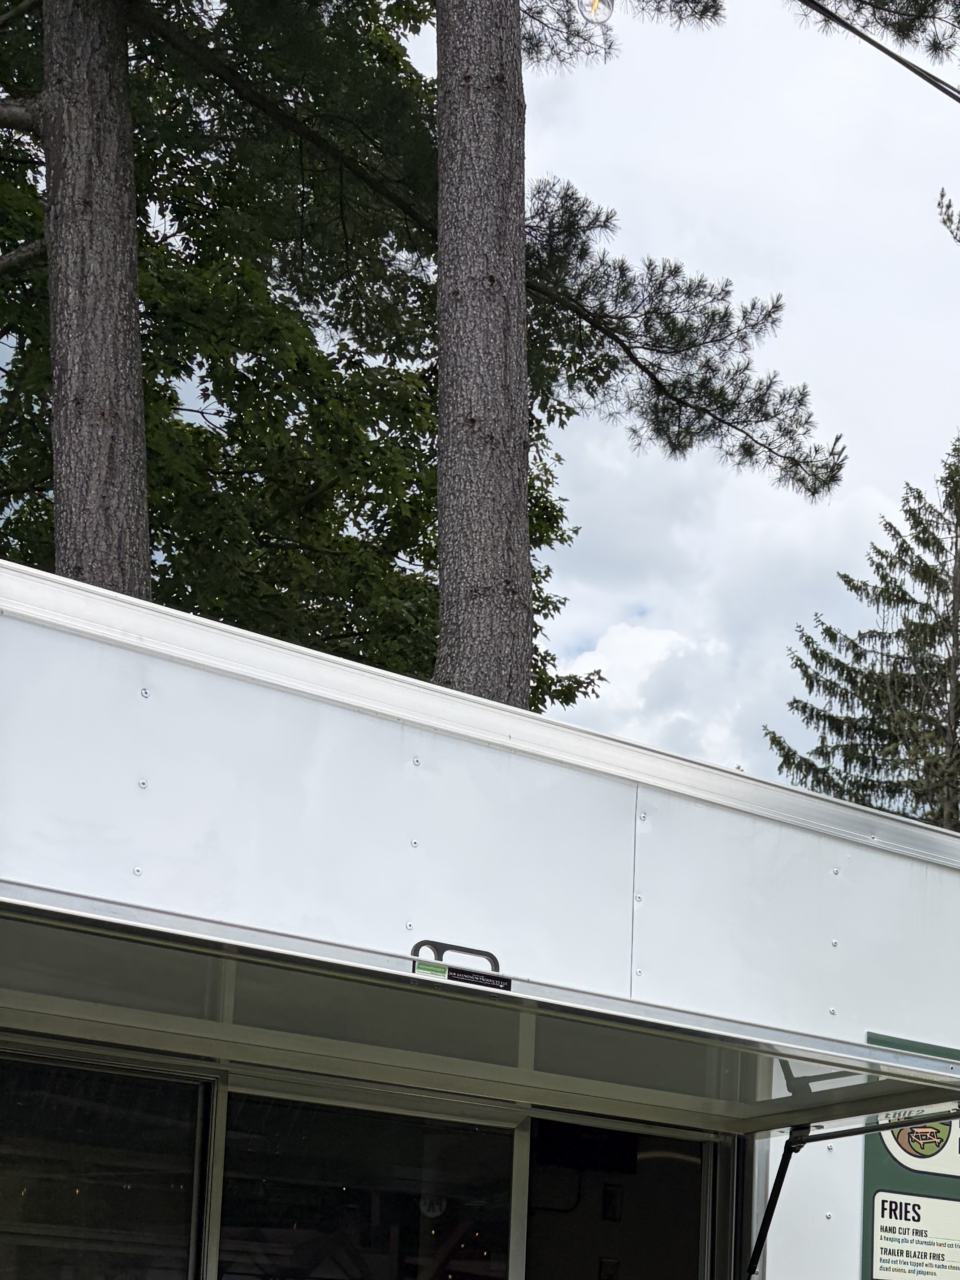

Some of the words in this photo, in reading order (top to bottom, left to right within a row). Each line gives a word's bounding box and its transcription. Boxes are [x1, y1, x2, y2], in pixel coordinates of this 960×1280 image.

[880, 1199, 922, 1222] FRIES
[880, 1224, 897, 1234] HAND
[897, 1226, 910, 1235] CUT
[911, 1228, 928, 1237] FRIES
[879, 1246, 904, 1257] TRAILER
[905, 1249, 928, 1259] BLAZER
[929, 1252, 945, 1261] FRIES
